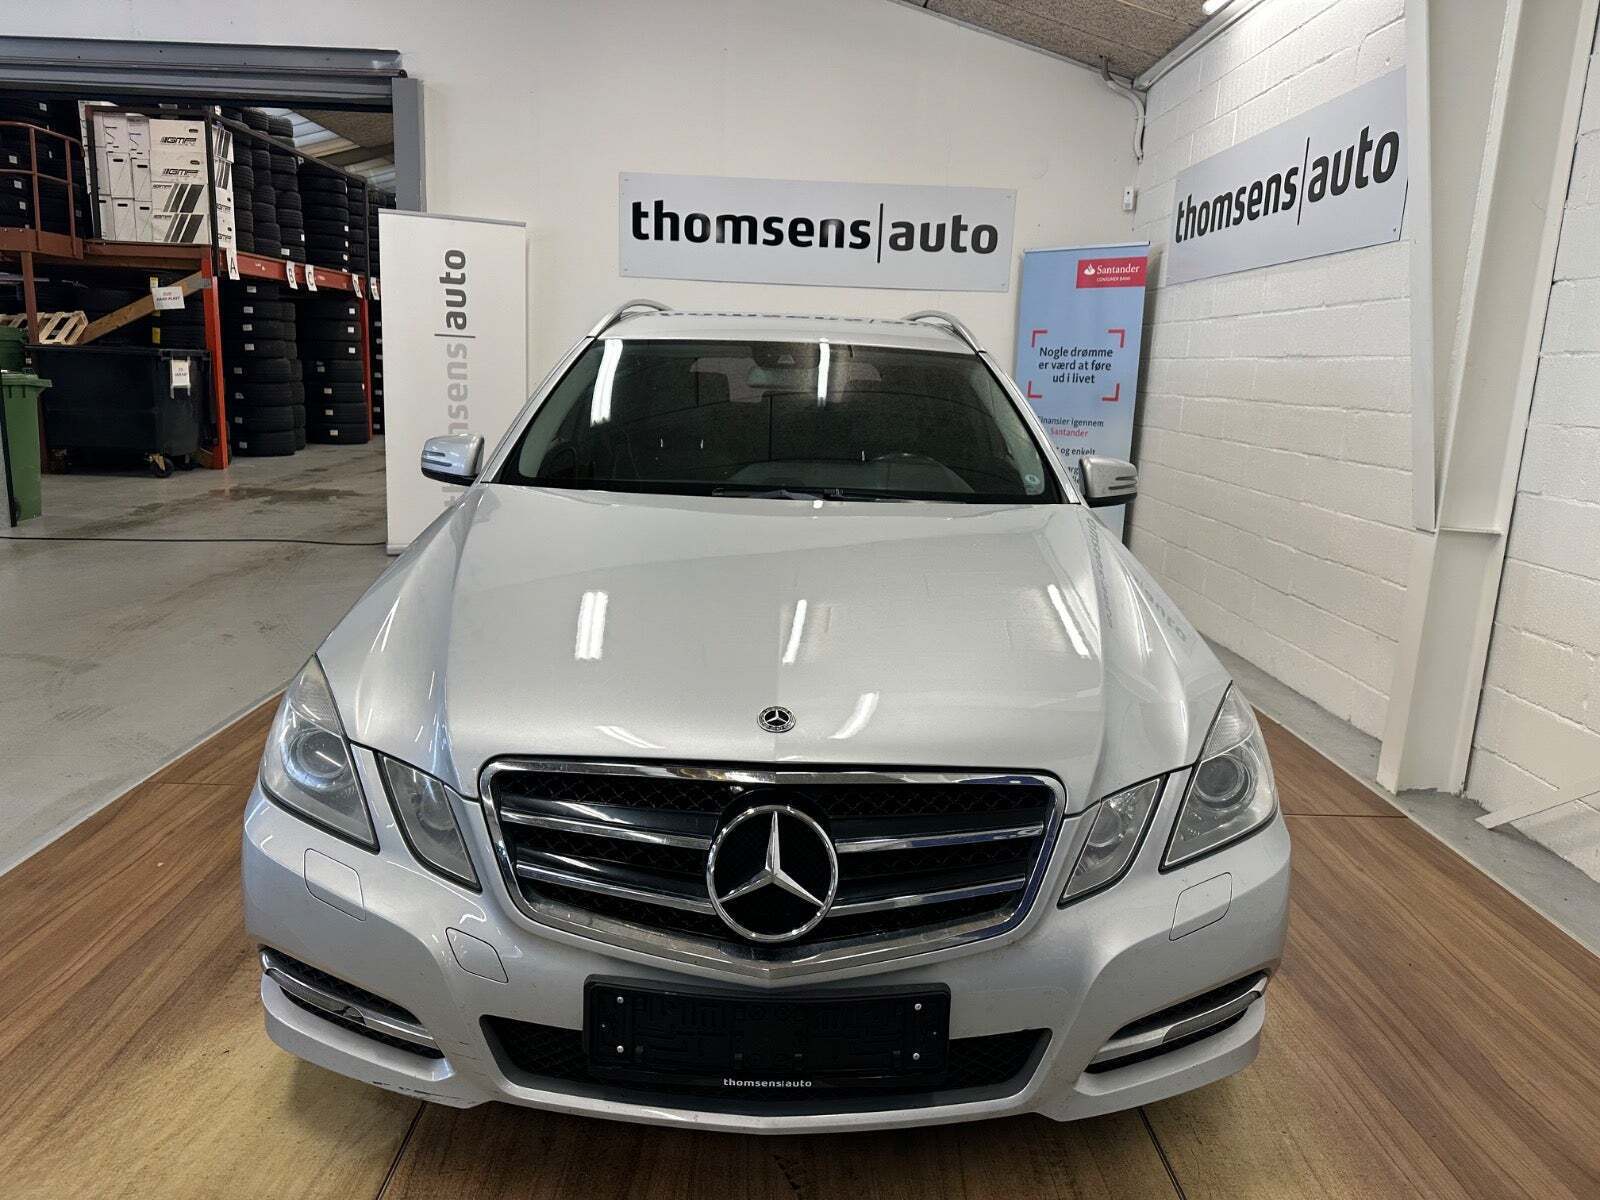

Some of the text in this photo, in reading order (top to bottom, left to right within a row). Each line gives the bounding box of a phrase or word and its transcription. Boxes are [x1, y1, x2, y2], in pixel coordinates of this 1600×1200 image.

[1307, 125, 1400, 203] auto
[888, 214, 999, 255] auto
[230, 257, 238, 274] A
[1096, 263, 1140, 274] Santander
[288, 267, 295, 284] B
[308, 271, 315, 289] C
[440, 250, 466, 330] auto
[1040, 346, 1113, 359] Nogle drømme
[1051, 360, 1075, 370] værd
[1078, 361, 1088, 370] at
[1092, 360, 1111, 371] føre
[1053, 373, 1095, 384] ud i livet
[1071, 416, 1104, 428] igennem
[1051, 427, 1088, 438] Santander
[1060, 448, 1070, 456] og
